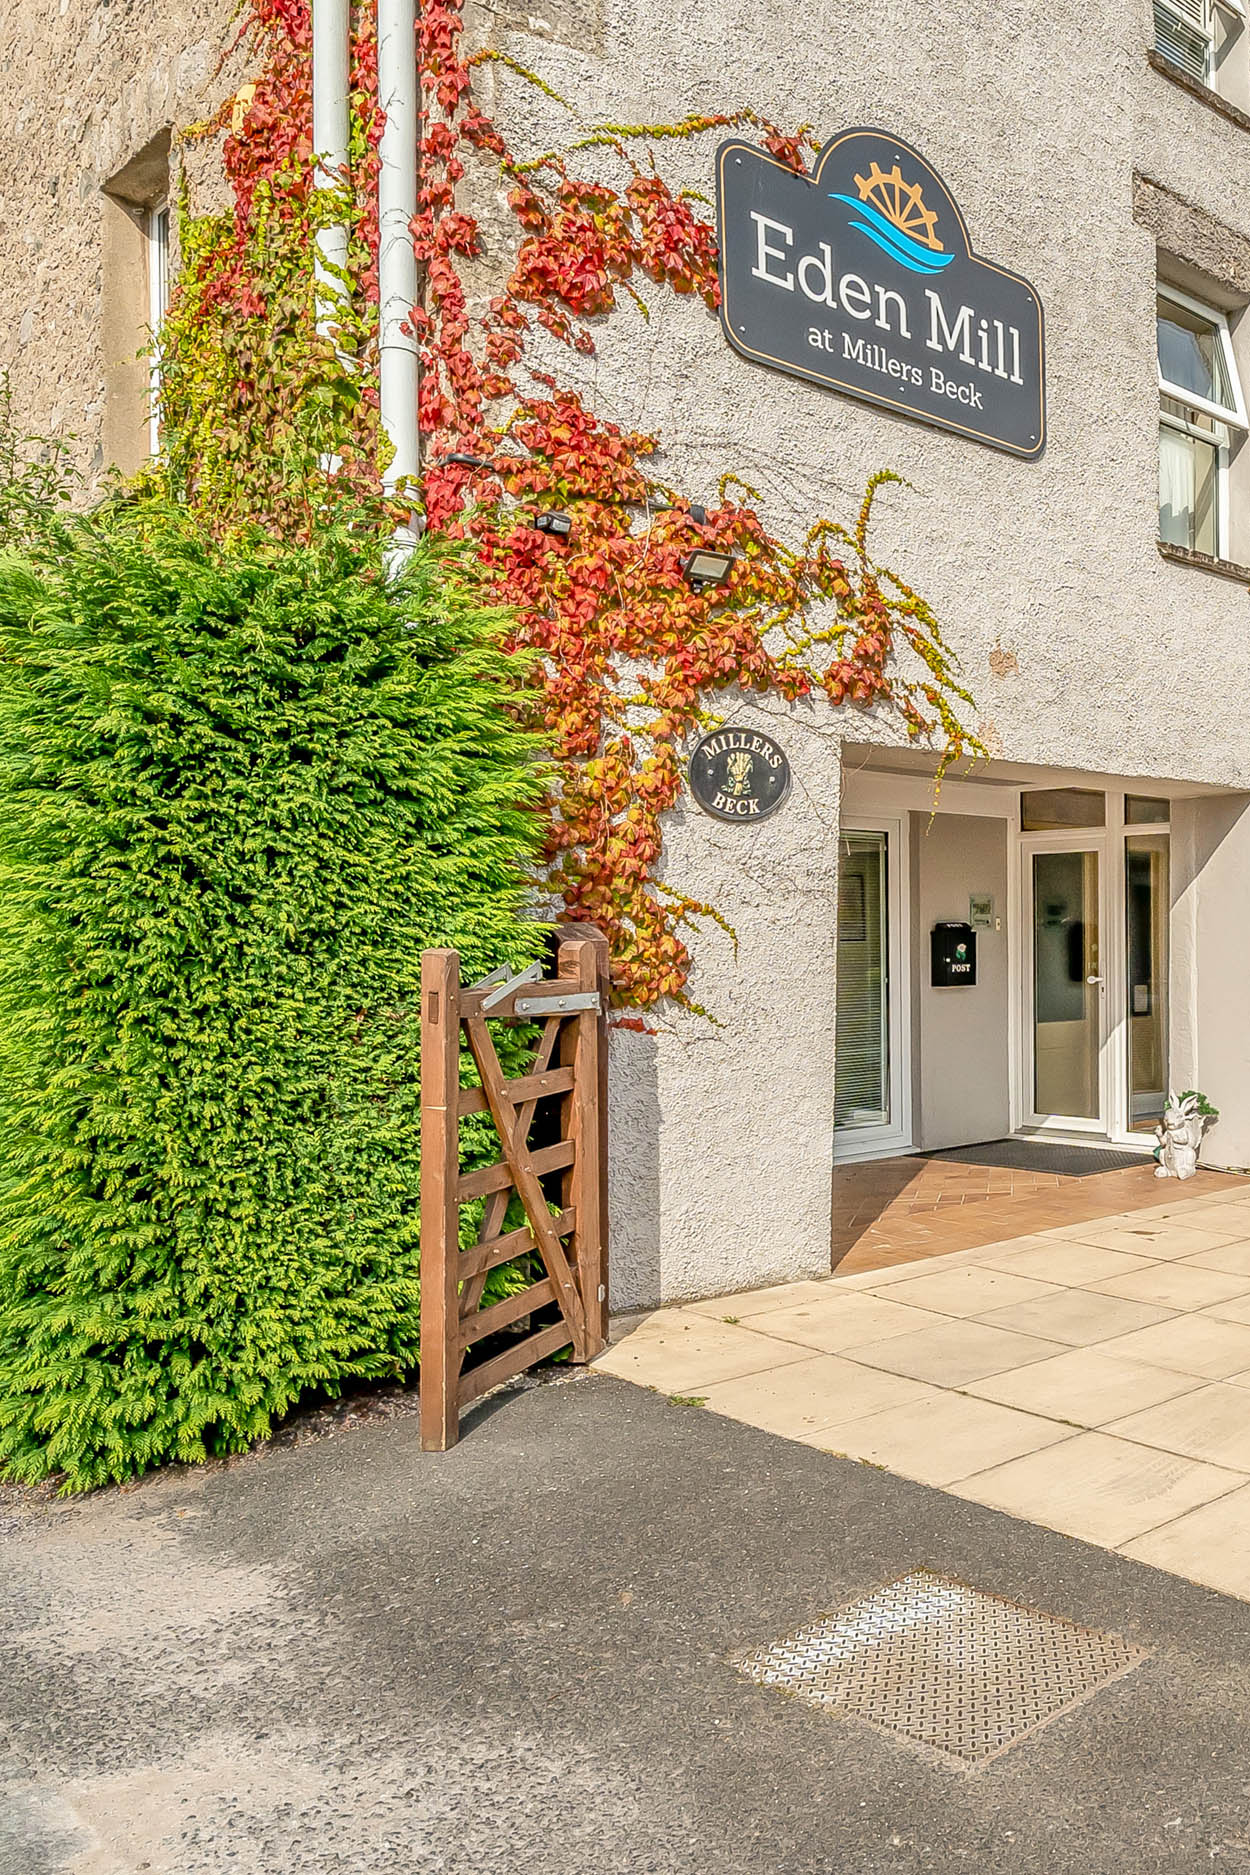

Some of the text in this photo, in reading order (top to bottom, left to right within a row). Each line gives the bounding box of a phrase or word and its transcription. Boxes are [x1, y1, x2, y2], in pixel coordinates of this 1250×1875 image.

[750, 210, 1024, 385] Eden Mill
[807, 326, 984, 410] at Millers Beck
[701, 733, 783, 769] MILLERS
[711, 792, 760, 815] BECK
[951, 964, 971, 973] POST
